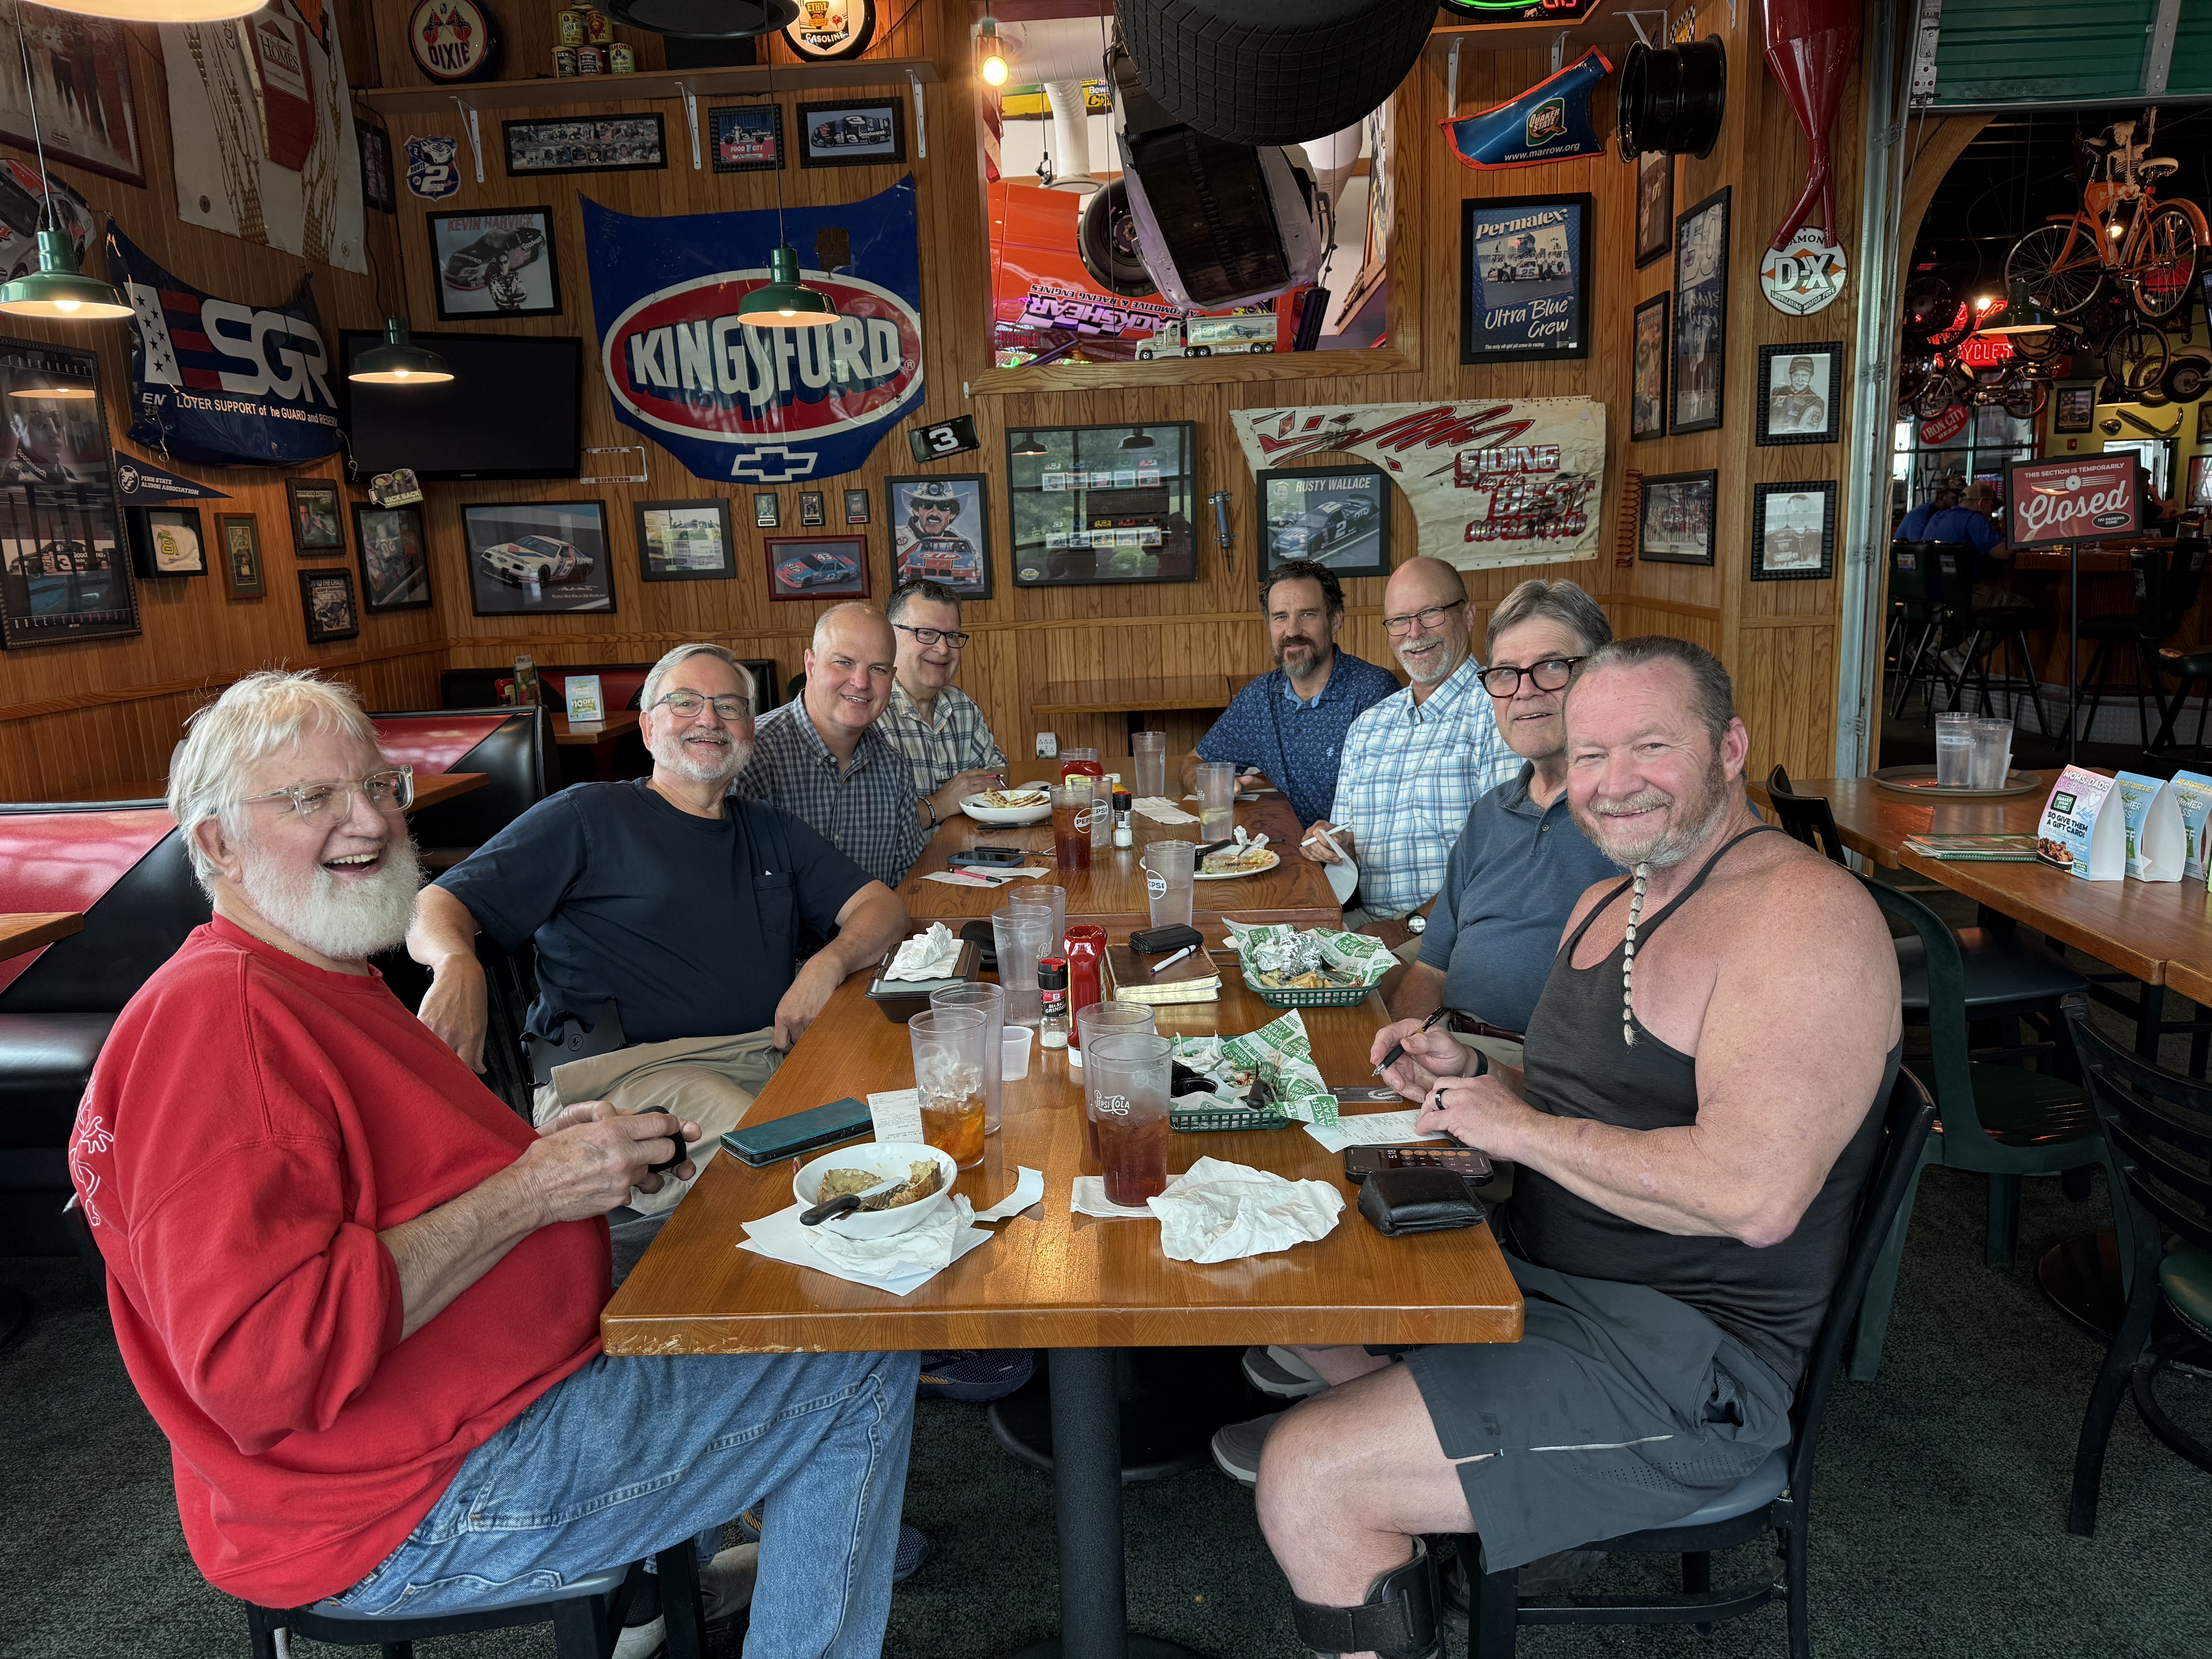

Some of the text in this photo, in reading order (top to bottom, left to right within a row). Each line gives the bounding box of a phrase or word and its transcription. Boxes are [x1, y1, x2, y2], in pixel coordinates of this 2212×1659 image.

[807, 2, 828, 11] ETHYL
[806, 31, 845, 43] GASOLINE
[258, 33, 299, 71] HOMES
[428, 42, 470, 70] DIXIE
[846, 116, 866, 125] 3
[1529, 108, 1560, 128] QUAKER
[1533, 117, 1556, 132] STATE
[847, 134, 859, 143] 3
[1504, 143, 1580, 161] www.marrow.org
[410, 162, 426, 173] ROUTE
[420, 165, 449, 192] 2
[447, 214, 534, 232] KEVIN HARVICK
[1520, 268, 1536, 278] 25
[1031, 284, 1075, 297] ENGINES
[1078, 292, 1116, 305] RACING
[1771, 287, 1835, 310] LUBRICATING MOTOR FUEL
[1485, 298, 1568, 330] Ultra Blue
[1527, 319, 1569, 338] Crew
[629, 314, 903, 407] KINGSFORD
[215, 400, 256, 415] SUPPORT
[258, 405, 267, 416] of
[270, 405, 280, 418] he
[281, 407, 306, 422] GUARD
[307, 413, 318, 424] and
[1922, 408, 1965, 441] IRON CITY
[929, 427, 959, 452] 3
[1457, 445, 1560, 485] SIDING
[2041, 468, 2070, 477] SECTION
[2078, 462, 2124, 472] TEMPORARILY
[141, 475, 155, 483] PENN
[1295, 477, 1371, 492] RUSTY WALLACE
[161, 484, 199, 495] ASSOCIATION
[385, 494, 401, 503] KICK
[401, 490, 420, 499] BACK
[2019, 480, 2130, 530] Closed
[1334, 520, 1346, 539] 2
[897, 537, 908, 545] STP
[57, 555, 72, 570] 3
[817, 553, 833, 561] 43
[559, 560, 573, 577] 6
[785, 562, 801, 574] STP
[824, 573, 836, 581] 43
[571, 699, 583, 708] $10
[2058, 778, 2091, 796] & GRADS
[2063, 769, 2110, 792] MOMS, DADS
[2052, 821, 2066, 831] GIFT
[2066, 827, 2085, 838] CARD!
[2056, 815, 2071, 825] GIVE
[2071, 820, 2088, 832] THEM
[1045, 1003, 1066, 1014] GRINDER
[1311, 1098, 1326, 1126] AKER
[1387, 1149, 1398, 1159] 5.18
